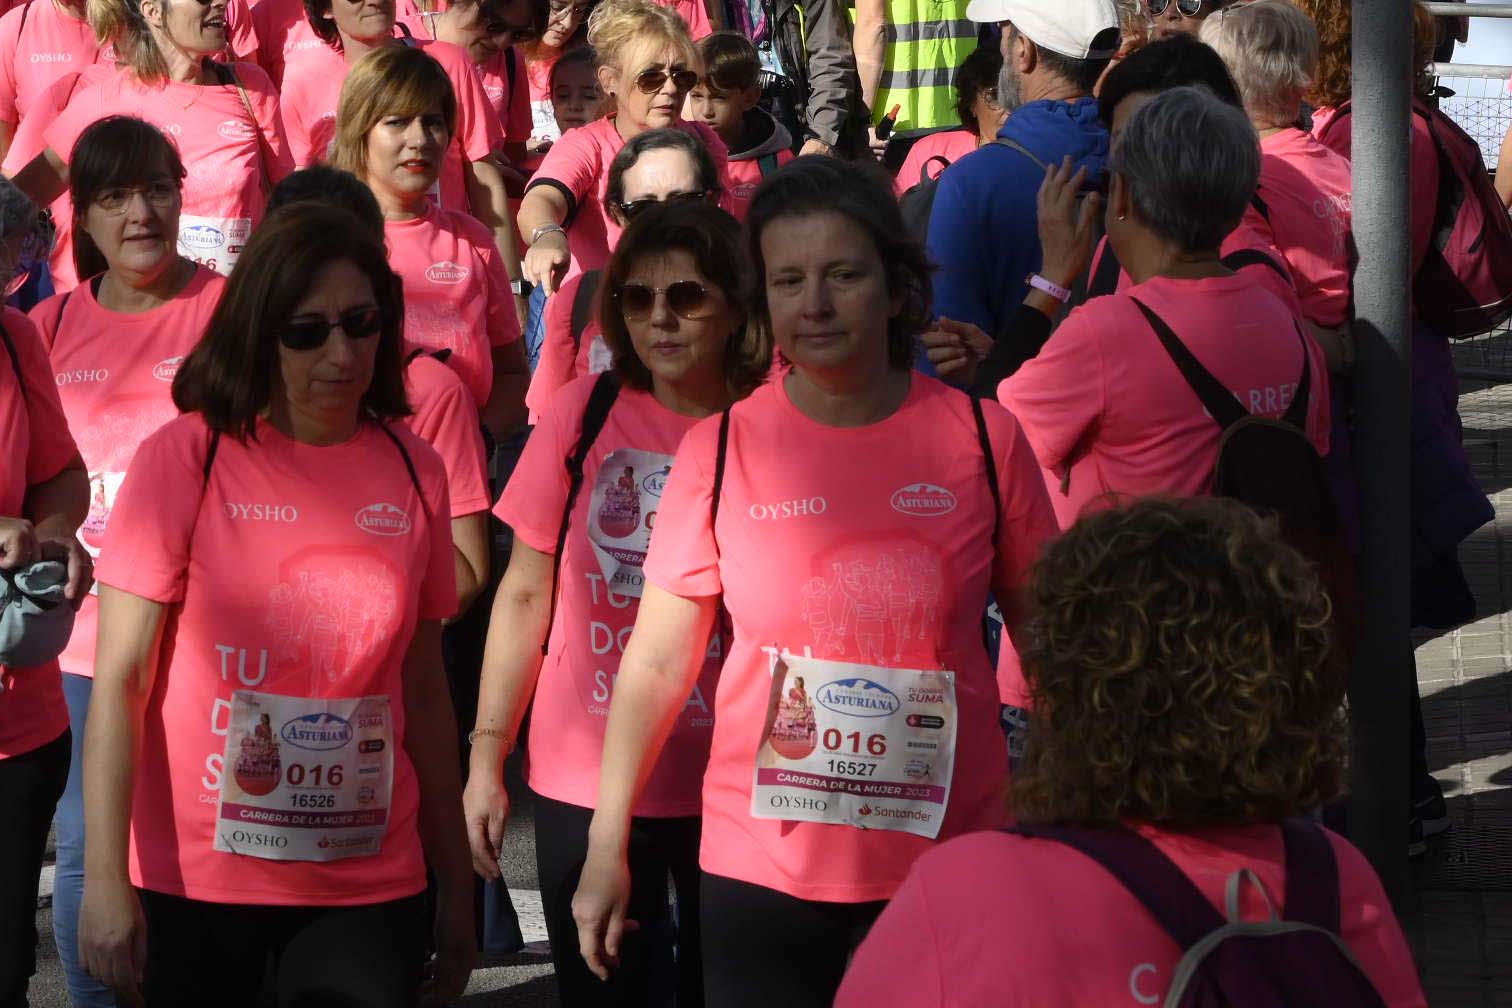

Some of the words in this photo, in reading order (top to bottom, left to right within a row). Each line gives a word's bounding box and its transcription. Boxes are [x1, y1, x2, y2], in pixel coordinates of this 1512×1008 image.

[56, 368, 109, 387] OYSHO
[224, 502, 298, 523] OYSHO
[750, 496, 827, 521] OYSHO
[896, 495, 953, 510] ASTURIANA
[215, 644, 268, 686] TU
[822, 688, 893, 713] ASTURIANA
[907, 693, 944, 705] SUMA
[288, 725, 350, 743] ASTURIANA
[822, 728, 888, 757] 016
[286, 763, 344, 787] 016
[827, 759, 878, 778] 16527
[776, 772, 828, 790] CARRERA
[829, 779, 846, 790] DE
[847, 782, 863, 793] LA
[863, 783, 903, 796] MUJER
[290, 793, 336, 809] 16526
[770, 794, 828, 812] OYSHO
[874, 804, 932, 823] Santander
[240, 809, 289, 824] CARRERA
[291, 815, 307, 824] DE
[307, 815, 321, 824] LA
[232, 829, 289, 849] OYSHO
